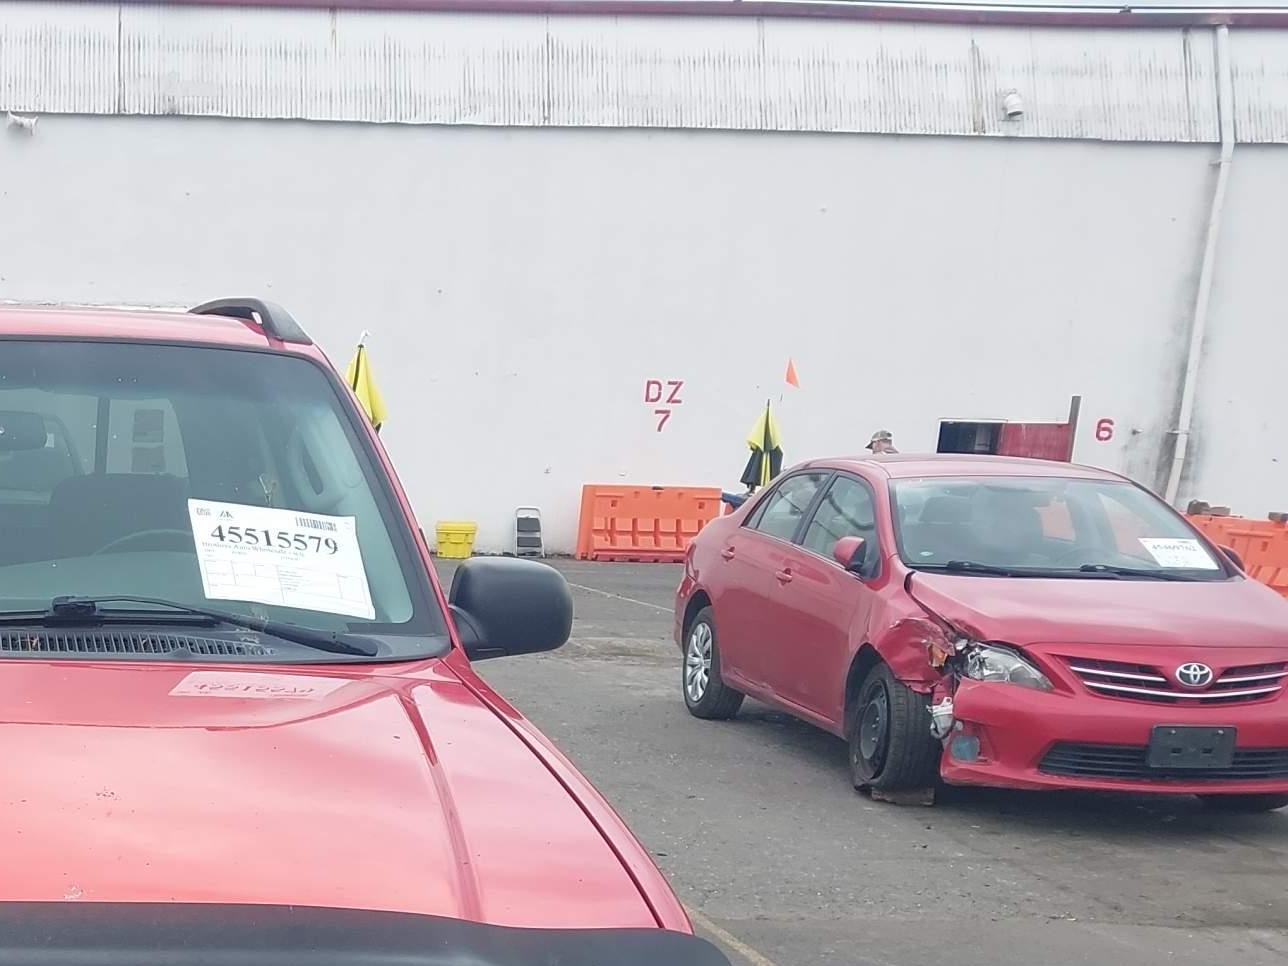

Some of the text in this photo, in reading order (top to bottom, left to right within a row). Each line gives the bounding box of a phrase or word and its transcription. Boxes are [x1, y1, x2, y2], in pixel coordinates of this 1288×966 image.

[645, 380, 683, 403] DZ
[655, 409, 671, 432] 7
[1096, 418, 1114, 441] 6
[211, 525, 338, 555] 45515579
